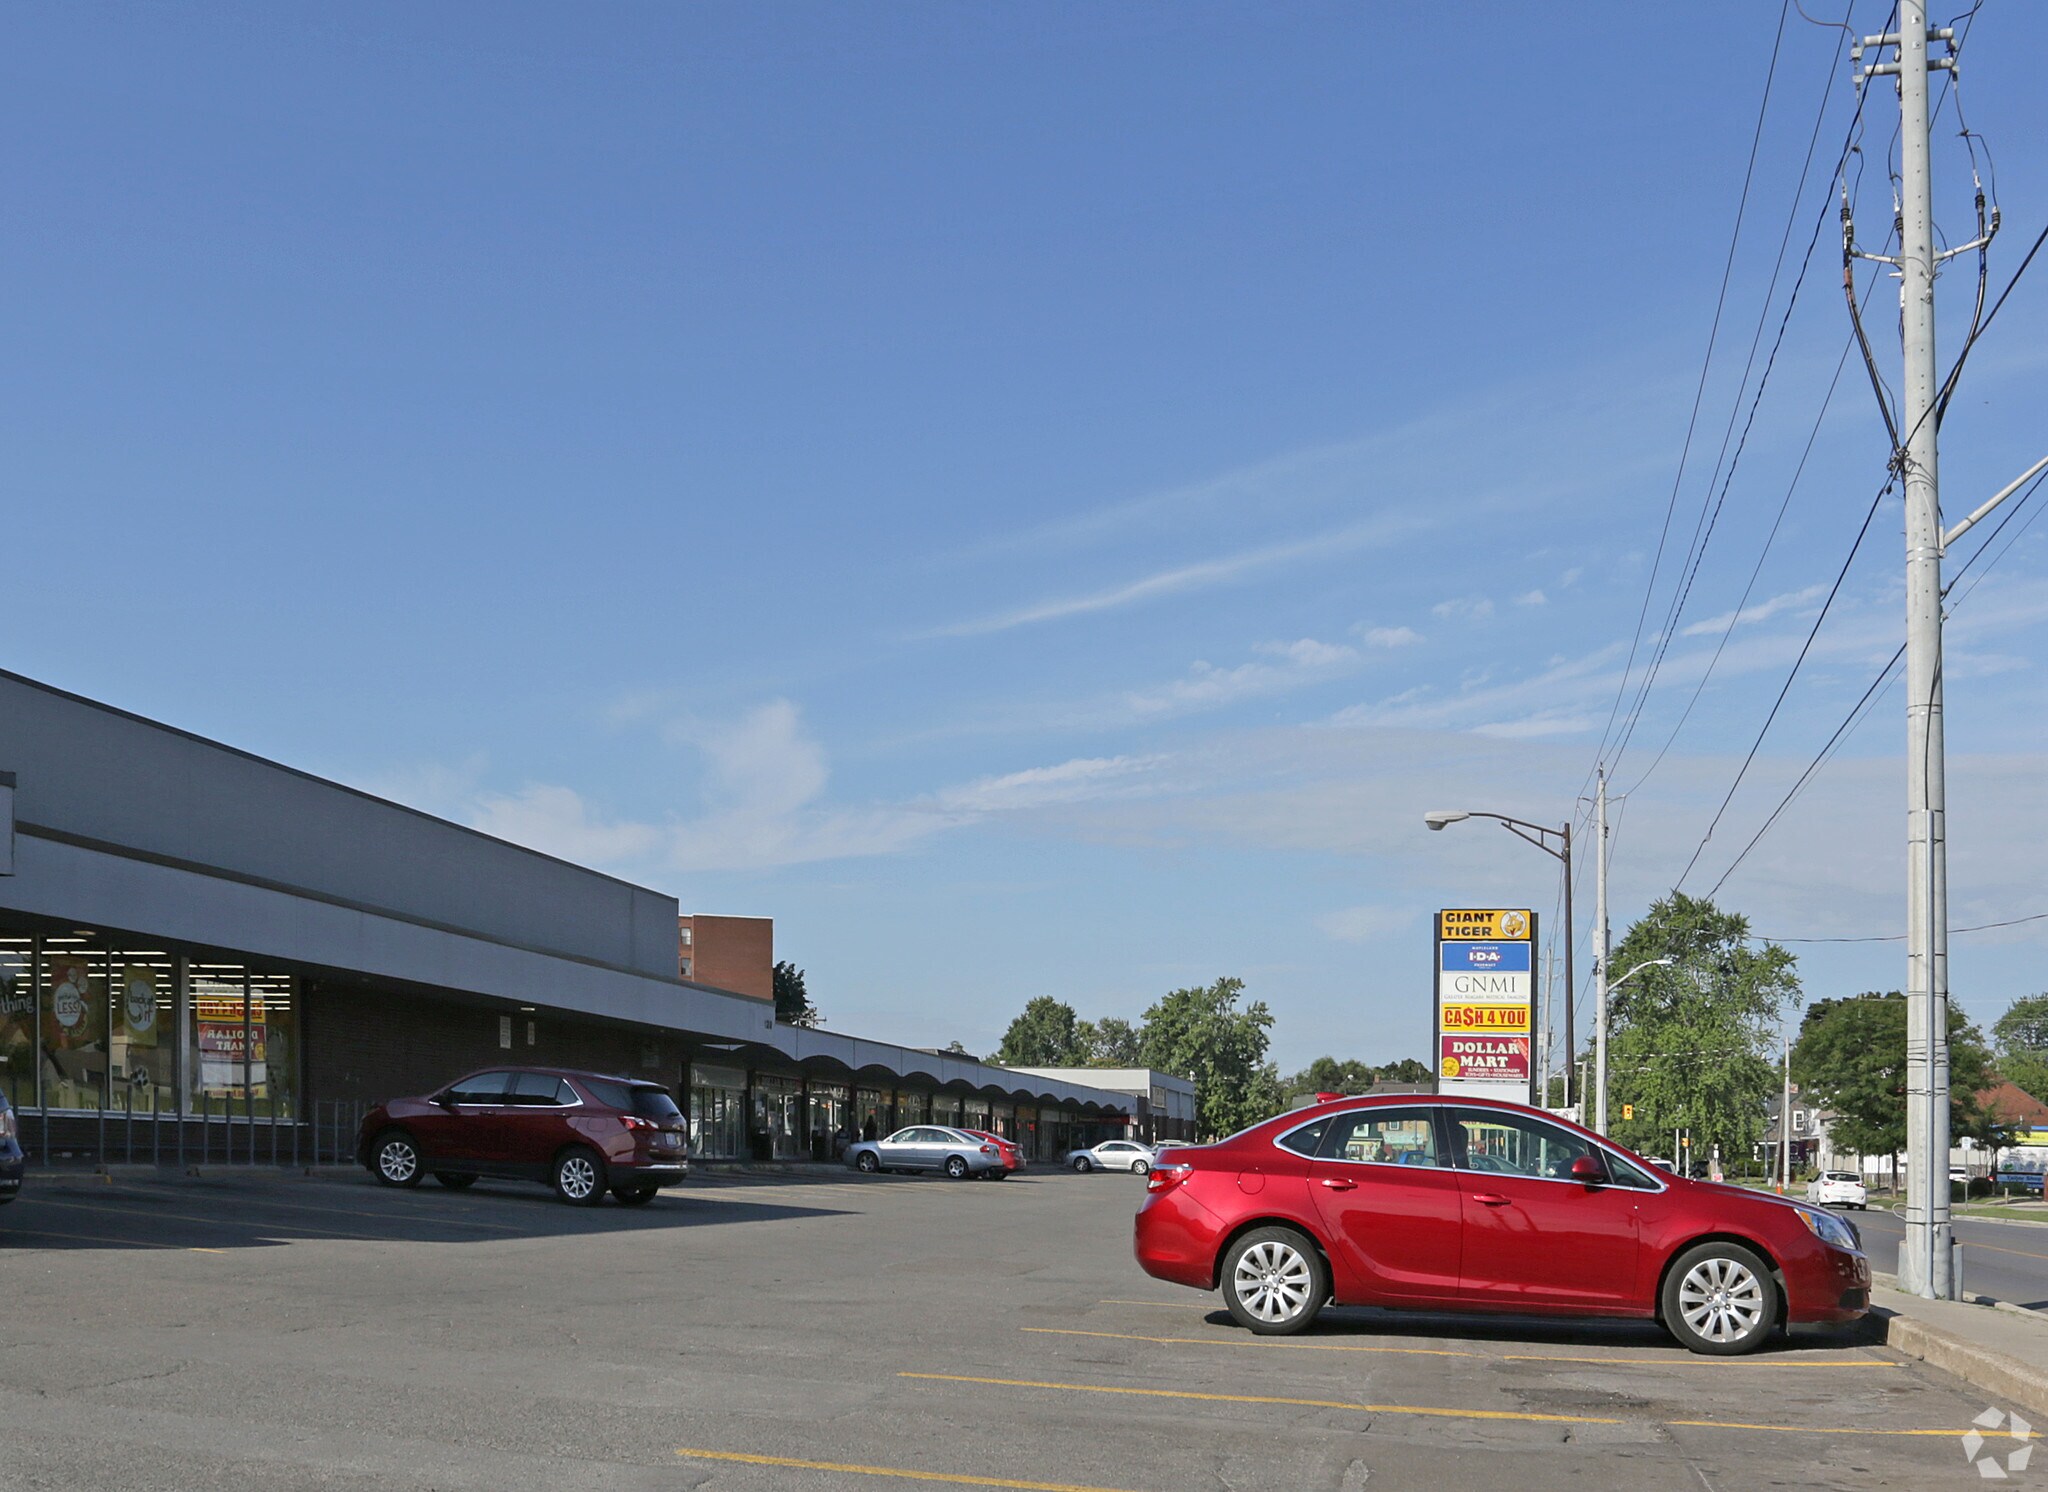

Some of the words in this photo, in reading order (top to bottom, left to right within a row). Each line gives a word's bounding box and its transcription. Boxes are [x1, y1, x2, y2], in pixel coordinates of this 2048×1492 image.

[1445, 913, 1494, 923] GIANT
[1445, 926, 1492, 936] TIGER
[1454, 975, 1516, 993] GNMI
[0, 994, 34, 1014] thing
[1444, 1007, 1483, 1027] CA$H
[1487, 1010, 1496, 1024] 4
[1499, 1010, 1526, 1025] YOU
[1452, 1041, 1520, 1054] DOLLAR
[1460, 1055, 1509, 1067] MART
